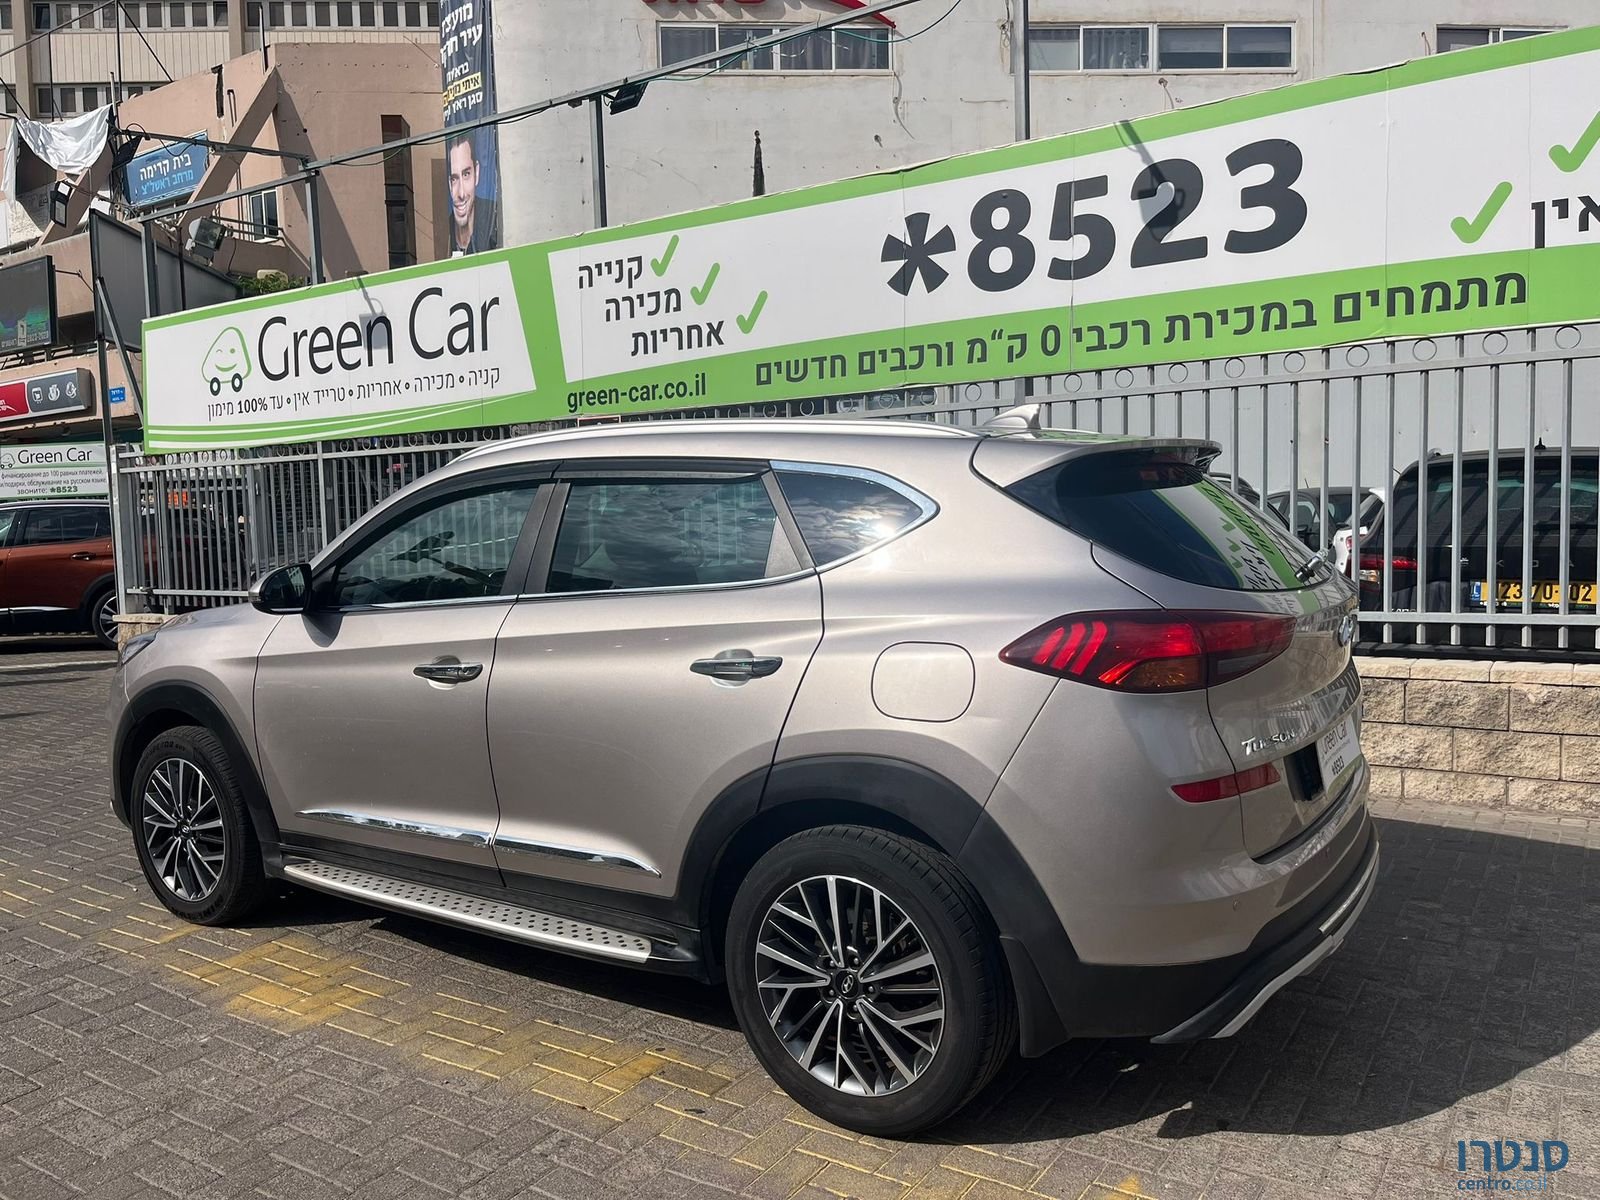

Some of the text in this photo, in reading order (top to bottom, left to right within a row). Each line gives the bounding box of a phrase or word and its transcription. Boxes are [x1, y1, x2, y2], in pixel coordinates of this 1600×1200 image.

[460, 23, 483, 47] עיר
[462, 75, 480, 91] איתי
[140, 153, 191, 181] בית קדימה
[172, 170, 194, 185] מרחב
[1531, 195, 1600, 249] אין
[578, 255, 643, 289] קנייה
[605, 287, 682, 322] מכירה
[1333, 272, 1527, 324] מתמחים
[257, 286, 500, 382] Green Car
[1072, 319, 1151, 353] רכבי
[1163, 298, 1318, 344] במכירת
[631, 320, 725, 357] אחריות
[756, 354, 847, 386] חדשים
[858, 341, 954, 376] ורכבים
[207, 367, 500, 422] קניה מכירה אחריות טרייד אין עד 100% מימון
[567, 372, 707, 414] green-car.co.il
[18, 447, 93, 464] Green Car
[17, 487, 48, 495] звоните:
